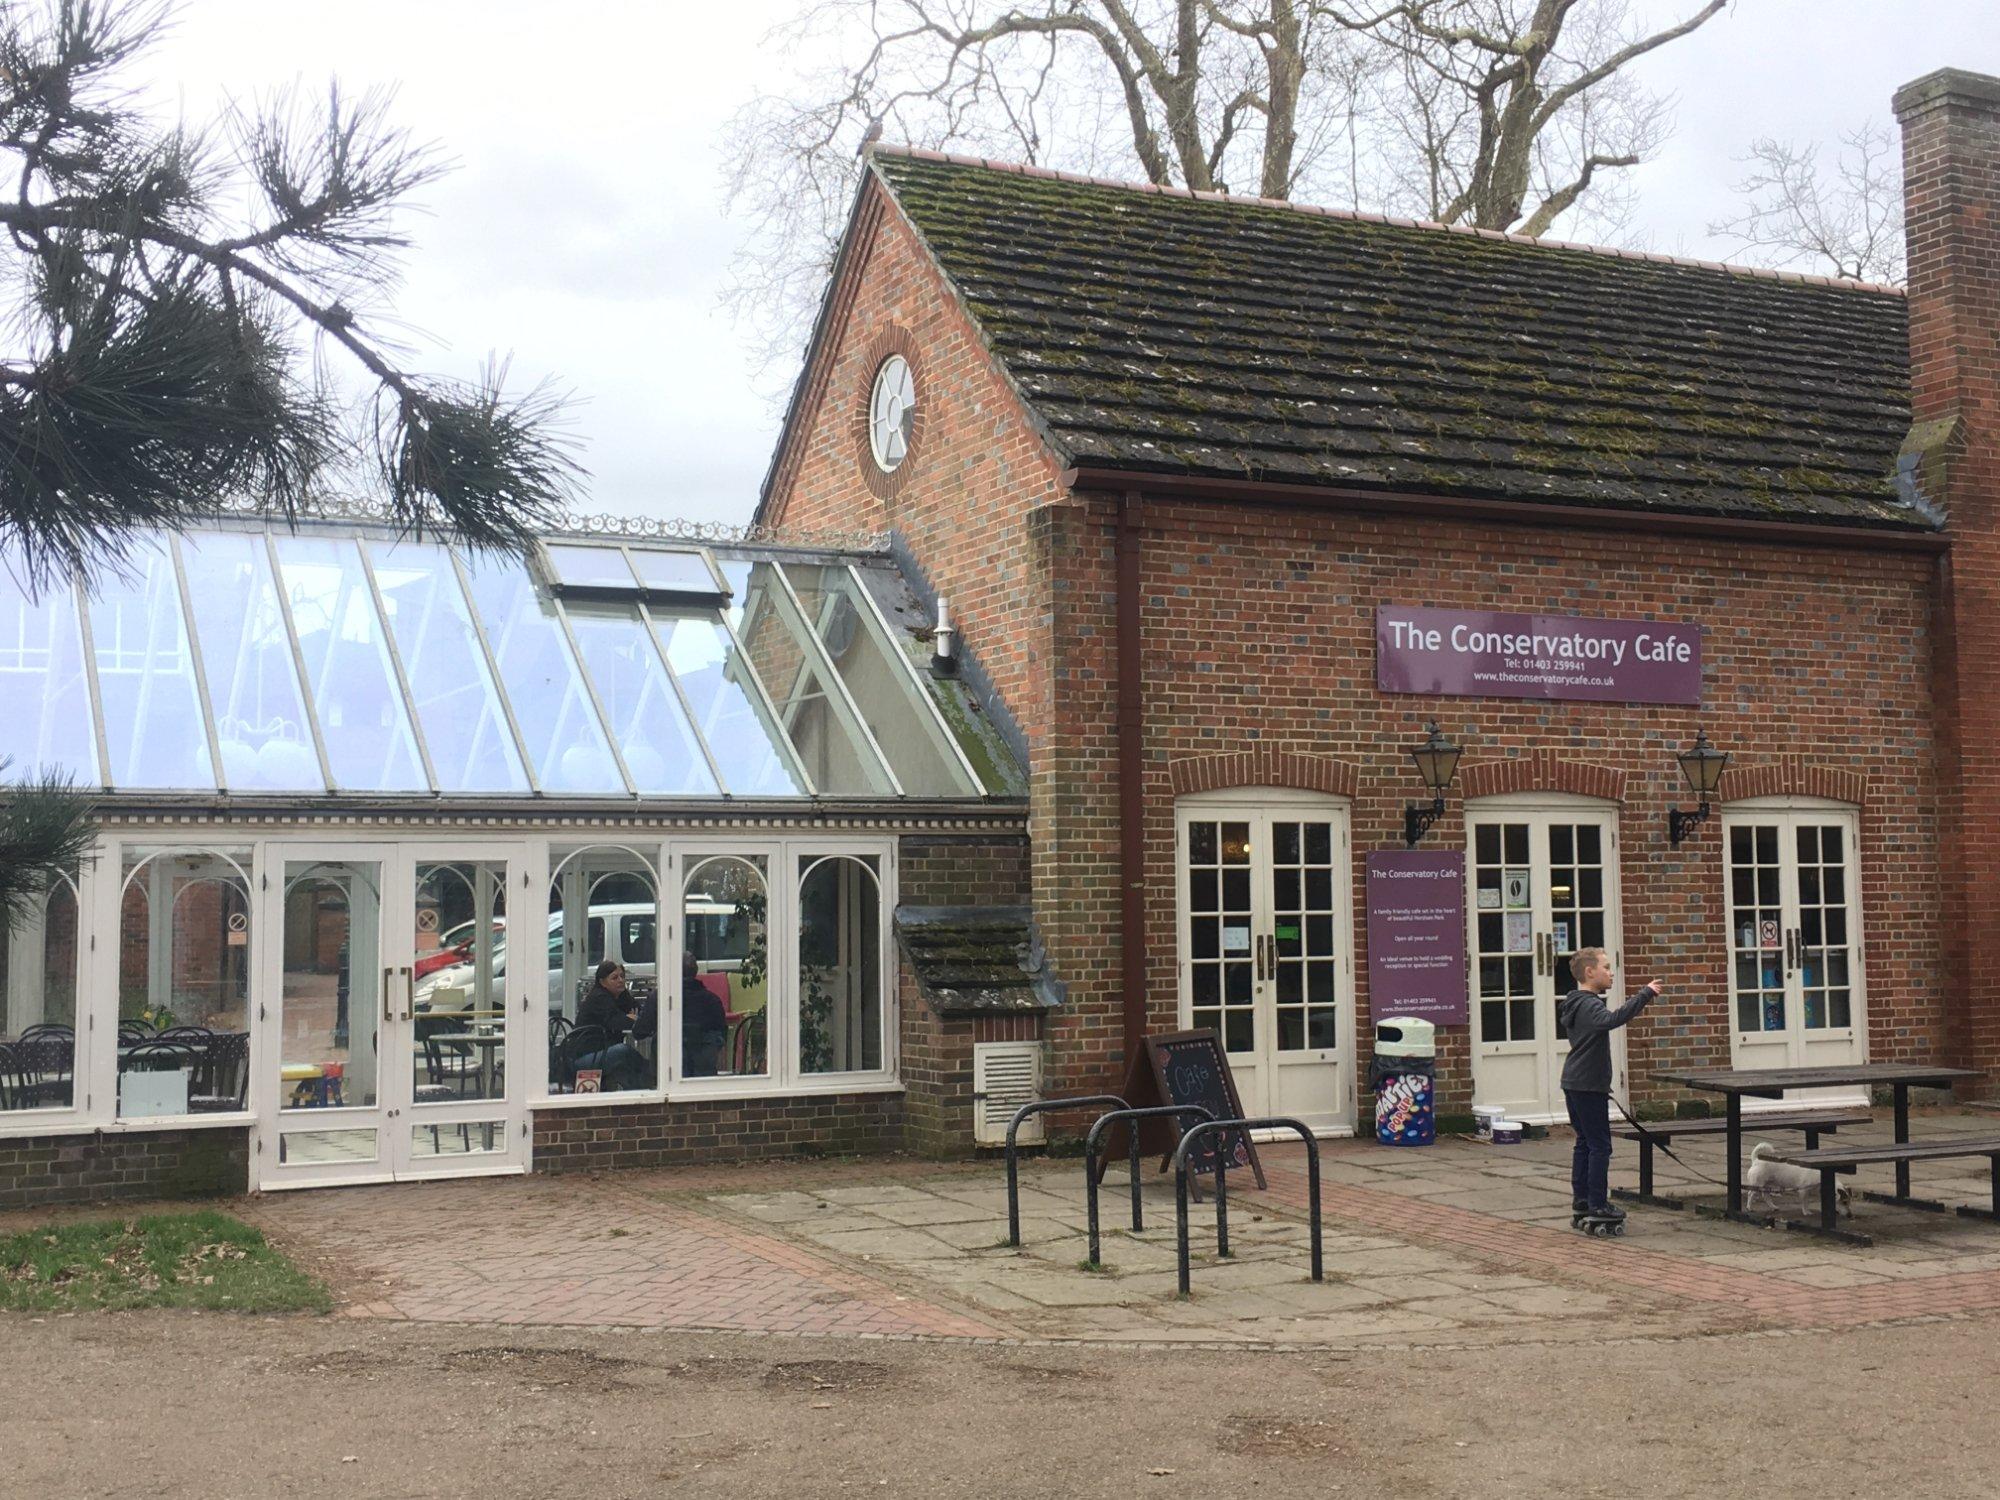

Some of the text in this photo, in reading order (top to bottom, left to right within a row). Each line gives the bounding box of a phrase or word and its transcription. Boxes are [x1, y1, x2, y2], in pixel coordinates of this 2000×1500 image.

[1388, 621, 1691, 666] The Conservatory Cafe
[1504, 658, 1585, 671] Tel: 01403 259941
[1474, 672, 1615, 686] www.theconservatorycafe.co.uk
[1372, 869, 1458, 880] The Conservatory Cafe
